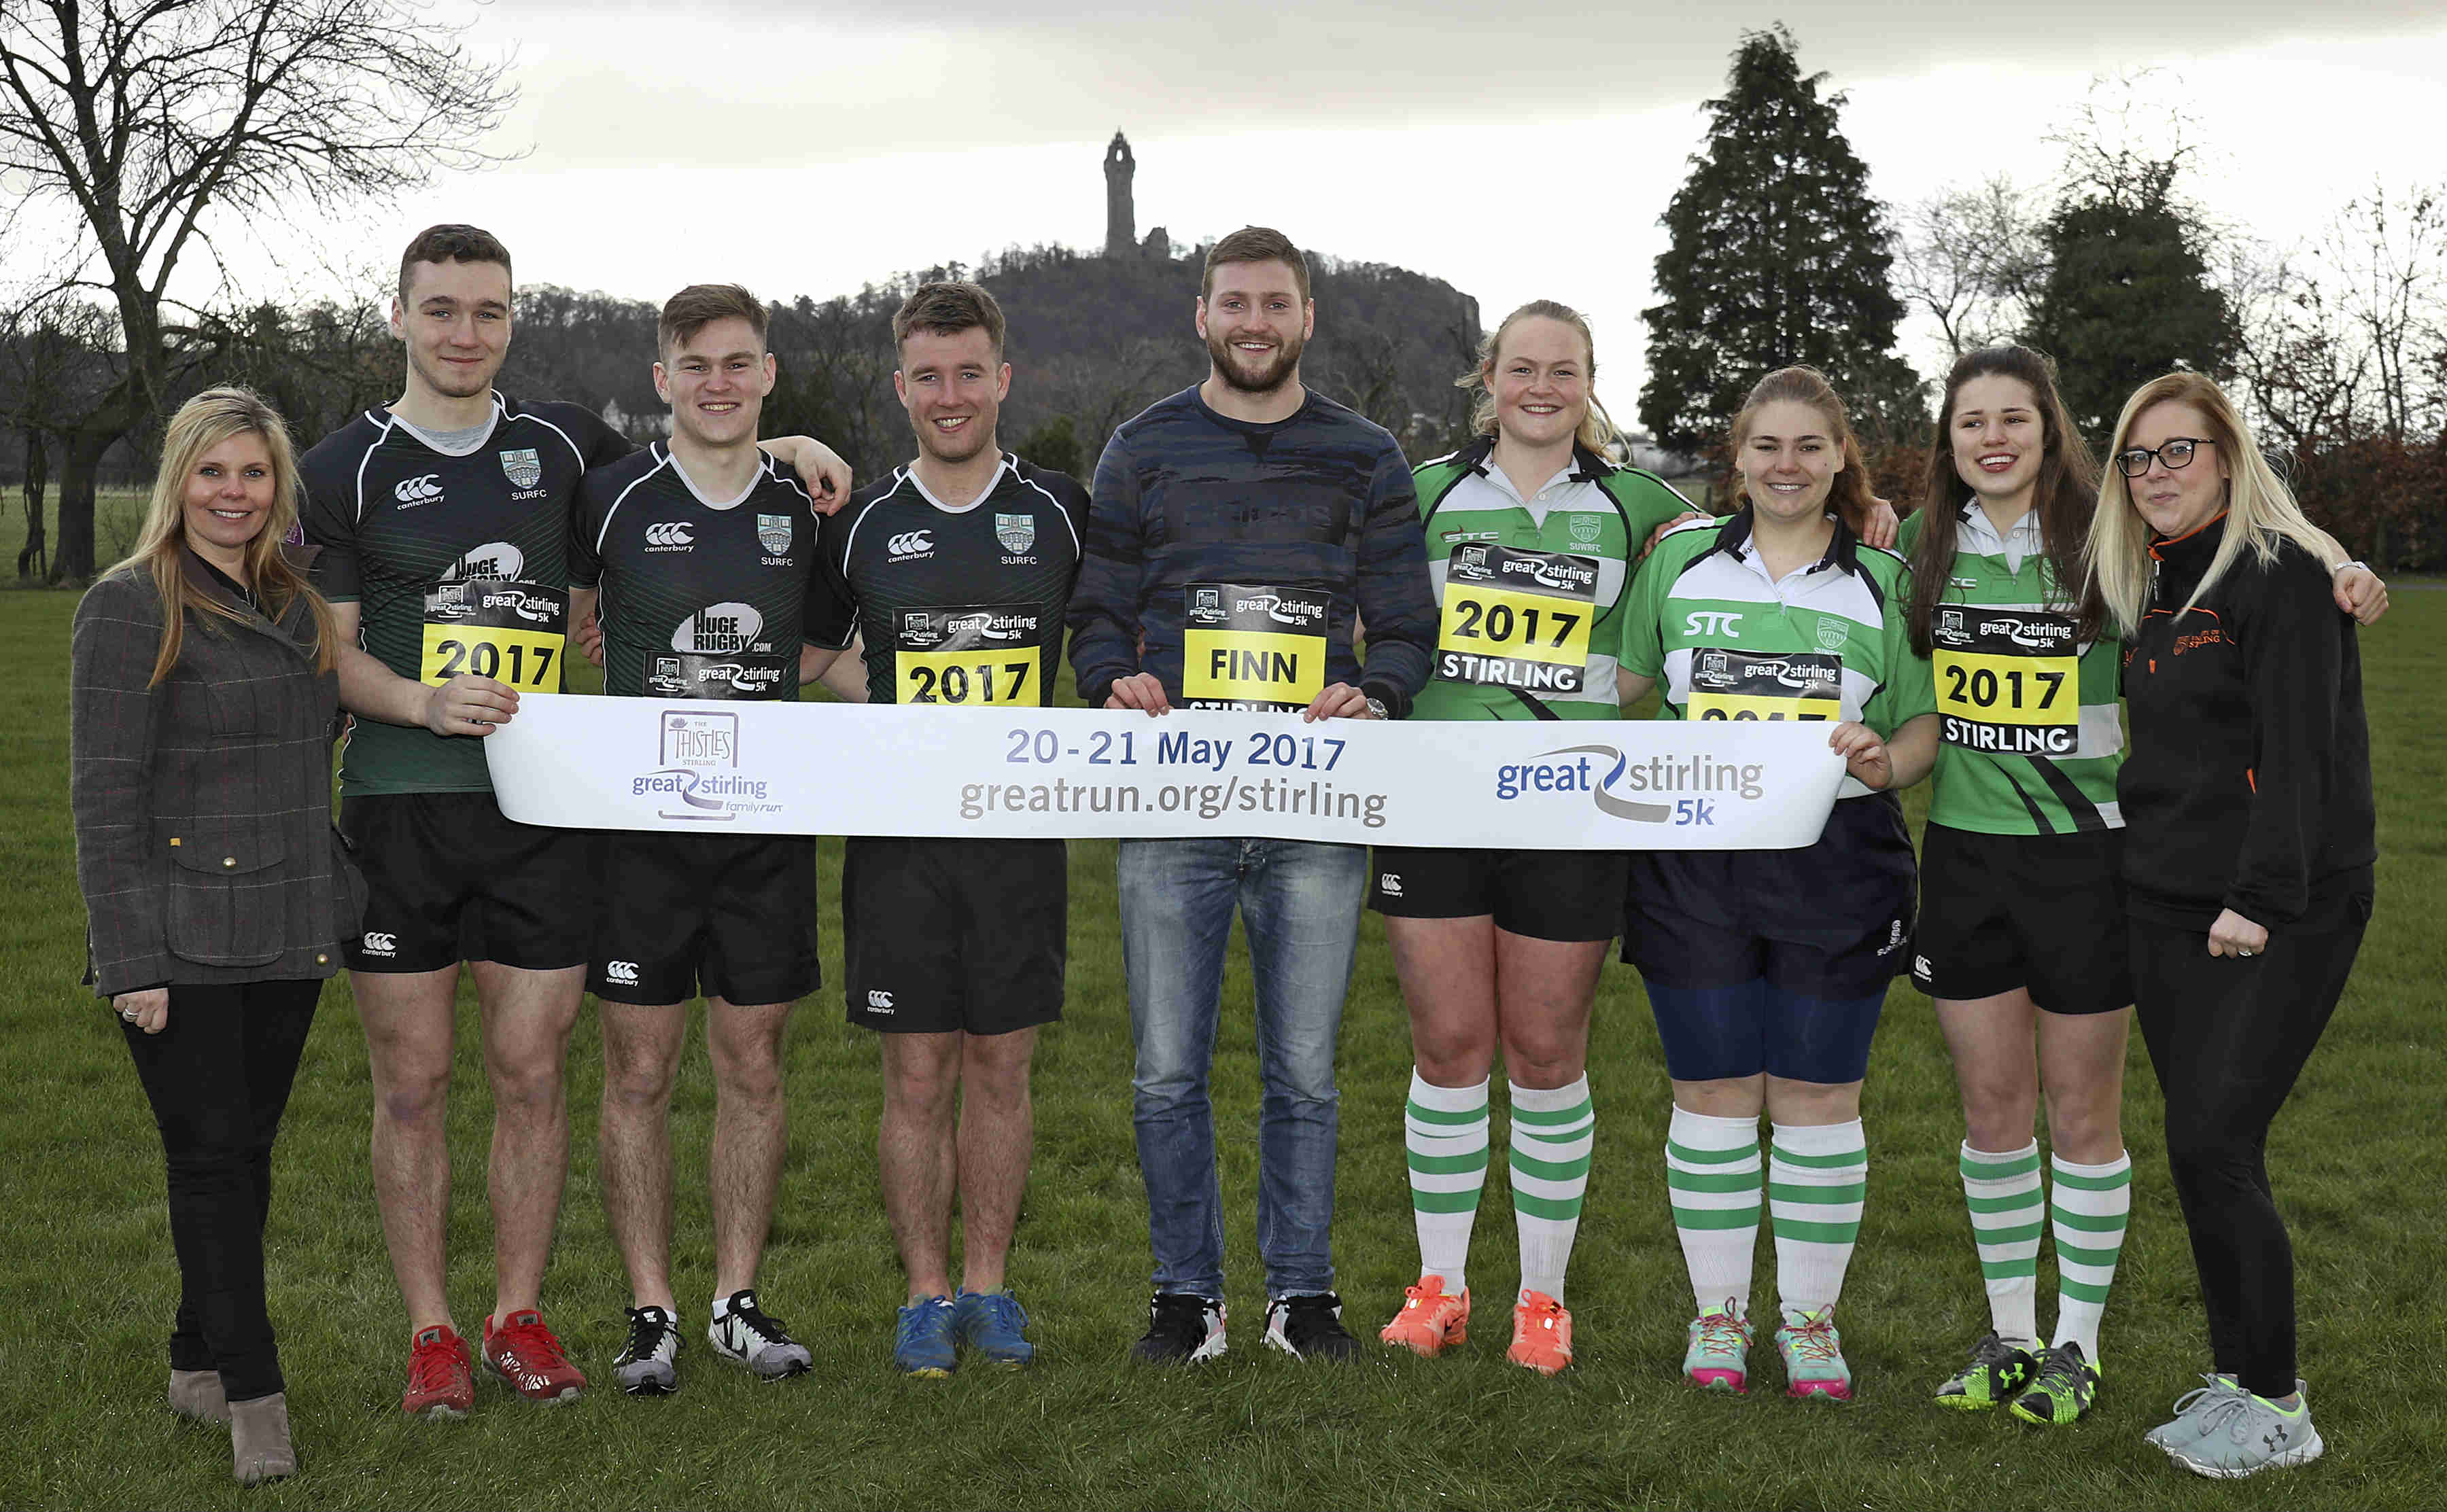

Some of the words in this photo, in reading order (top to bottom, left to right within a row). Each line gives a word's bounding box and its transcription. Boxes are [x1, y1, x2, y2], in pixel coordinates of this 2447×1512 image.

[397, 494, 445, 510] canterbury
[511, 489, 547, 501] SURFC
[644, 544, 695, 553] canterbury
[888, 551, 935, 563] canterbury
[455, 554, 498, 579] HUGE
[761, 557, 793, 567] SURFC
[1001, 556, 1037, 565] SURFC
[1502, 559, 1535, 574] great
[1547, 566, 1593, 584] stirling
[1561, 580, 1576, 591] 5k
[483, 594, 517, 608] great
[525, 596, 559, 616] stirling
[1236, 598, 1270, 612] great
[1281, 601, 1323, 619] stirling
[538, 612, 549, 623] 5k
[693, 610, 737, 634] HUGE
[948, 617, 981, 633] great
[993, 615, 1037, 629] stirling
[1294, 615, 1308, 626] 5k
[1451, 599, 1581, 648] 2017
[1683, 612, 1743, 637] STC
[1008, 630, 1022, 640] 5k
[1979, 620, 2011, 635] great
[2022, 622, 2071, 639] stirling
[693, 633, 749, 651] RUGBY
[2039, 638, 2054, 648] 5k
[435, 639, 555, 685] 2017
[1211, 649, 1298, 684] FINN
[1744, 662, 1778, 678] great
[1790, 663, 1837, 682] stirling
[698, 667, 731, 682] great
[743, 667, 780, 684] stirling
[1442, 654, 1577, 691] STIRLING
[755, 681, 767, 692] 5k
[909, 663, 1030, 703] 2017
[1805, 680, 1818, 690] 5k
[1945, 665, 2065, 709] 2017
[669, 728, 730, 759] THISTLES
[1946, 718, 2070, 752] STIRLING
[1157, 731, 1232, 773] May
[1248, 733, 1347, 772] 2017
[632, 775, 682, 795] great
[701, 775, 767, 799] stirling
[1496, 757, 1591, 800] great
[1629, 755, 1764, 800] stirling
[959, 776, 1387, 828] greatrun.org/stirling
[1675, 798, 1715, 826] 5k
[362, 948, 396, 958] canterbury
[606, 977, 638, 986] canterbury
